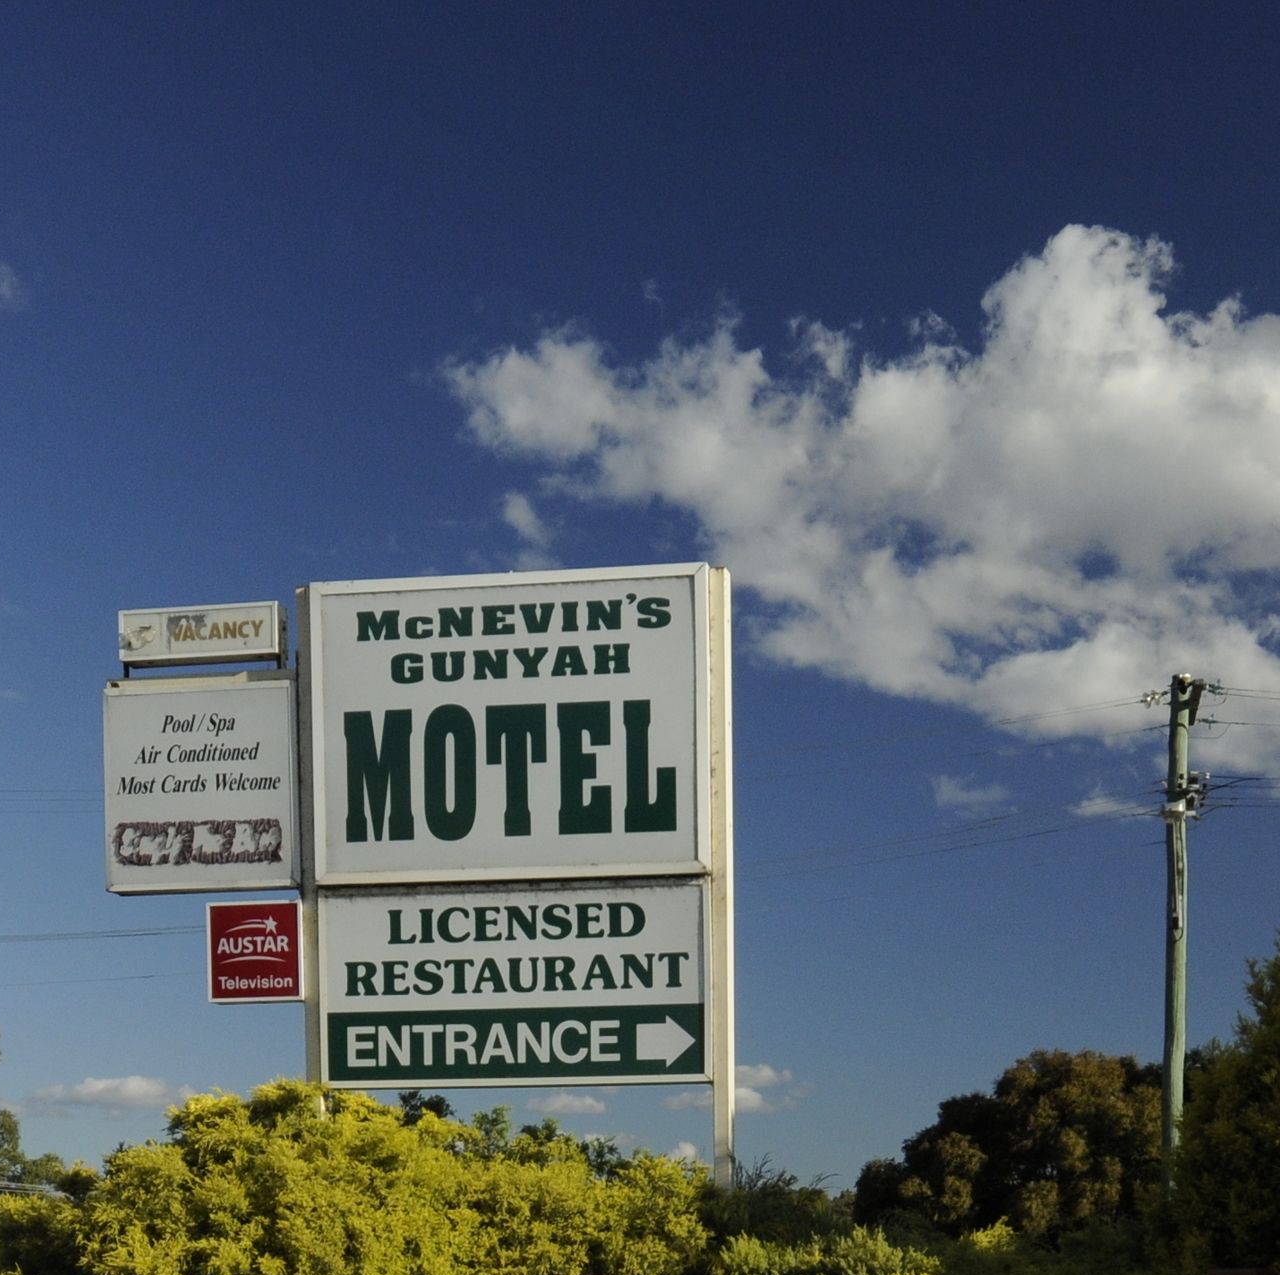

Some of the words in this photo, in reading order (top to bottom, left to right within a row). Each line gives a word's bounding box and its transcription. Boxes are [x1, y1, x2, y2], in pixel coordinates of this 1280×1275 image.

[356, 592, 672, 642] McNEVIN'S
[390, 643, 631, 684] GUNYAH
[134, 745, 162, 764] Air
[166, 742, 260, 764] Conditioned
[343, 699, 677, 843] MOTEL
[117, 776, 157, 795] Most
[160, 774, 208, 794] Cards
[214, 772, 281, 792] Welcome
[387, 901, 647, 945] LICENSED
[217, 935, 289, 955] AUSTAR
[218, 974, 293, 990] Television
[344, 952, 690, 997] RESTAURANT
[346, 1019, 621, 1068] ENTRANCE
